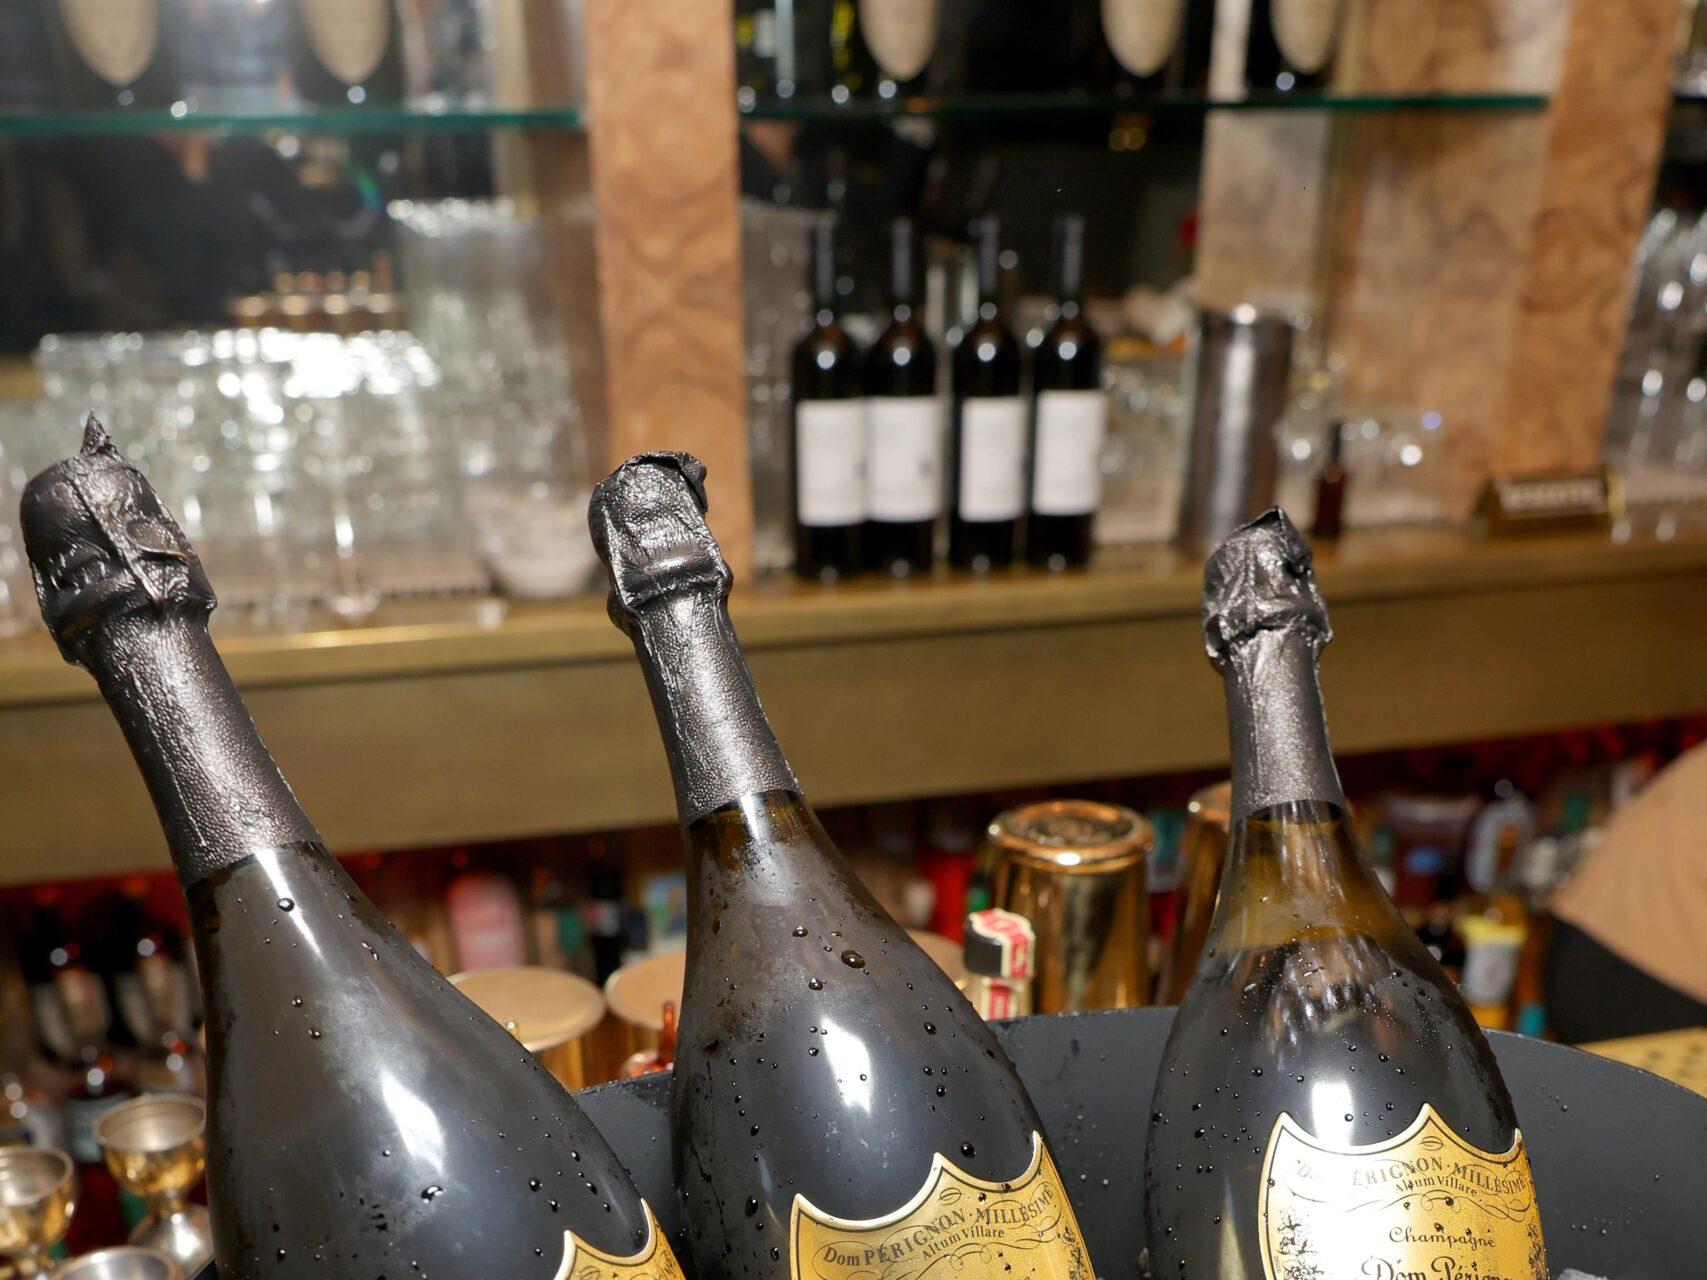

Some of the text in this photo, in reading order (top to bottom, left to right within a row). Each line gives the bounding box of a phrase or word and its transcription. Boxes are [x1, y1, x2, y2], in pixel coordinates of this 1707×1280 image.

[1353, 1157, 1443, 1186] ÉRIGNON
[1437, 1176, 1477, 1196] Villare
[922, 1225, 1005, 1261] Altum Villare
[1389, 1227, 1496, 1251] Champagne
[823, 1247, 860, 1266] Dom
